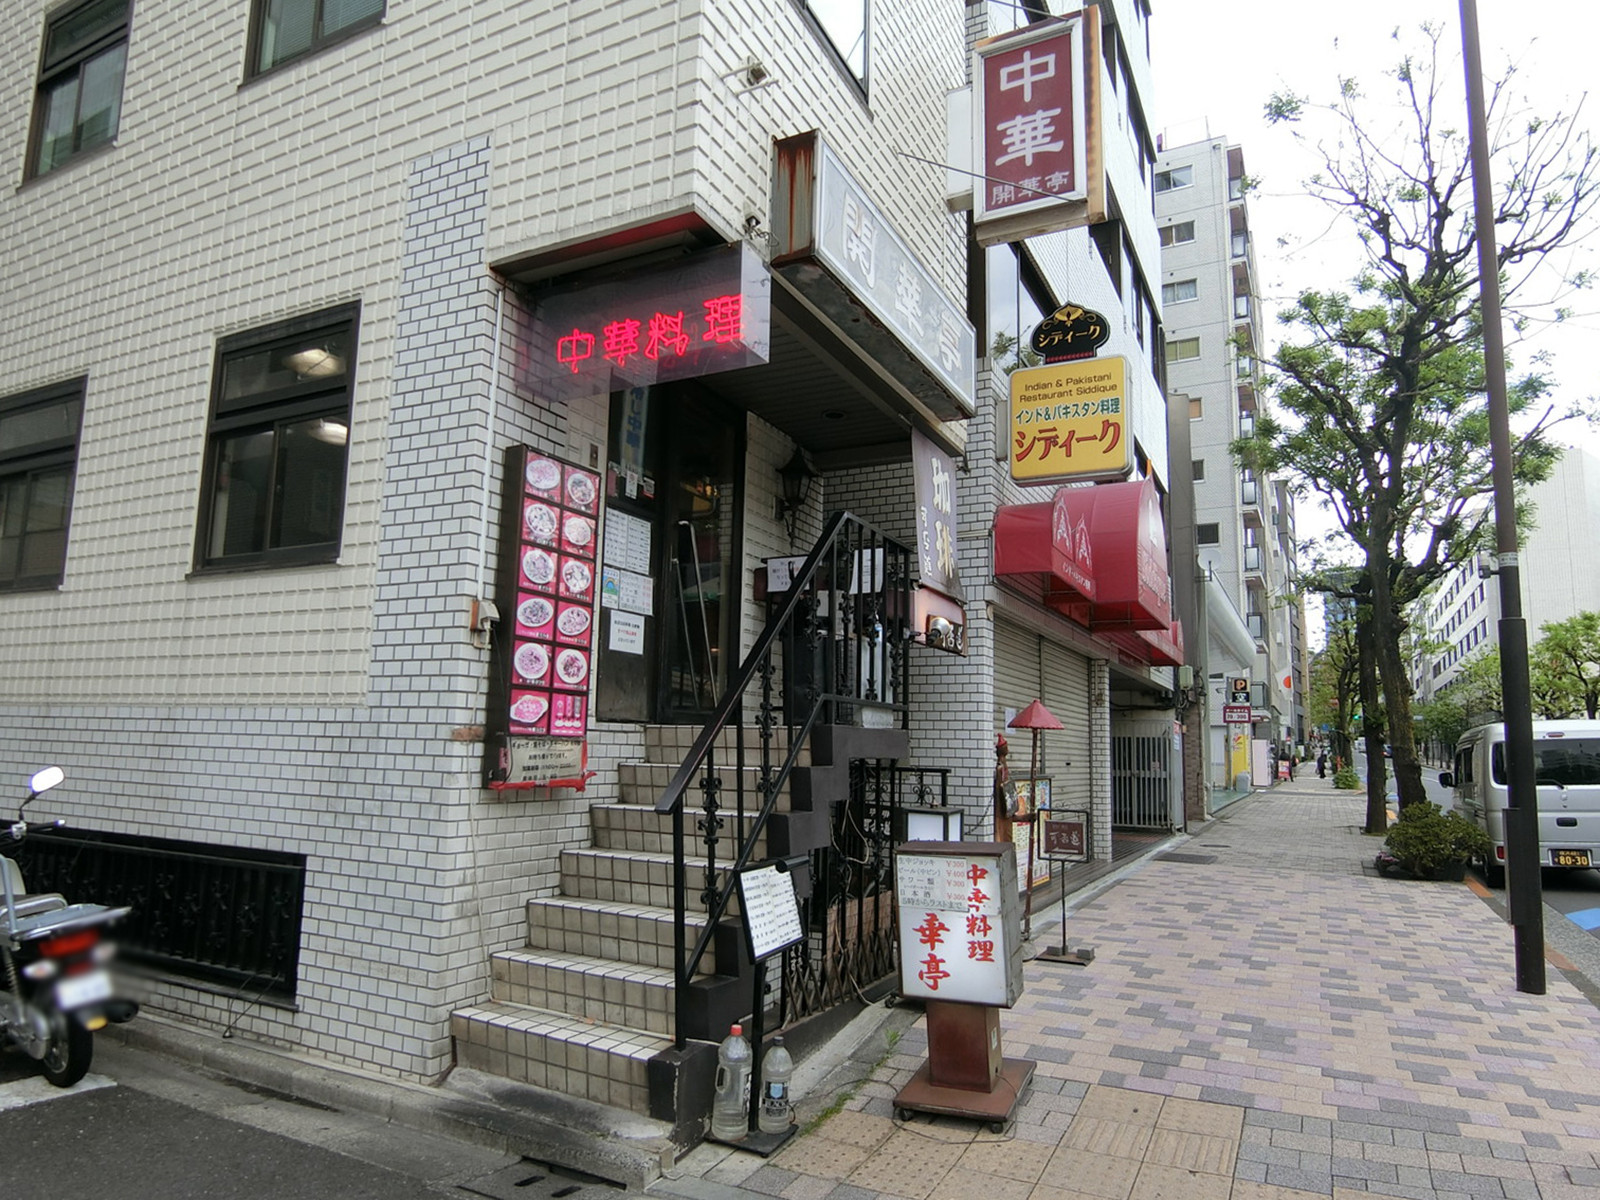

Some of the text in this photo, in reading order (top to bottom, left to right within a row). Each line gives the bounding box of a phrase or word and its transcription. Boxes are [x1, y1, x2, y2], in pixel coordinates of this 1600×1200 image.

[995, 50, 1064, 167] 中華
[991, 171, 1070, 205] 開華亭
[557, 294, 744, 373] 中華料理
[1038, 324, 1101, 347] シディーク
[1019, 383, 1118, 403] Restaurant Siddique
[1024, 372, 1112, 392] Indian & Pakistani
[1015, 397, 1120, 425] インド&パキスタン料理
[1015, 419, 1121, 462] シディーク
[1559, 856, 1587, 865] 80-30
